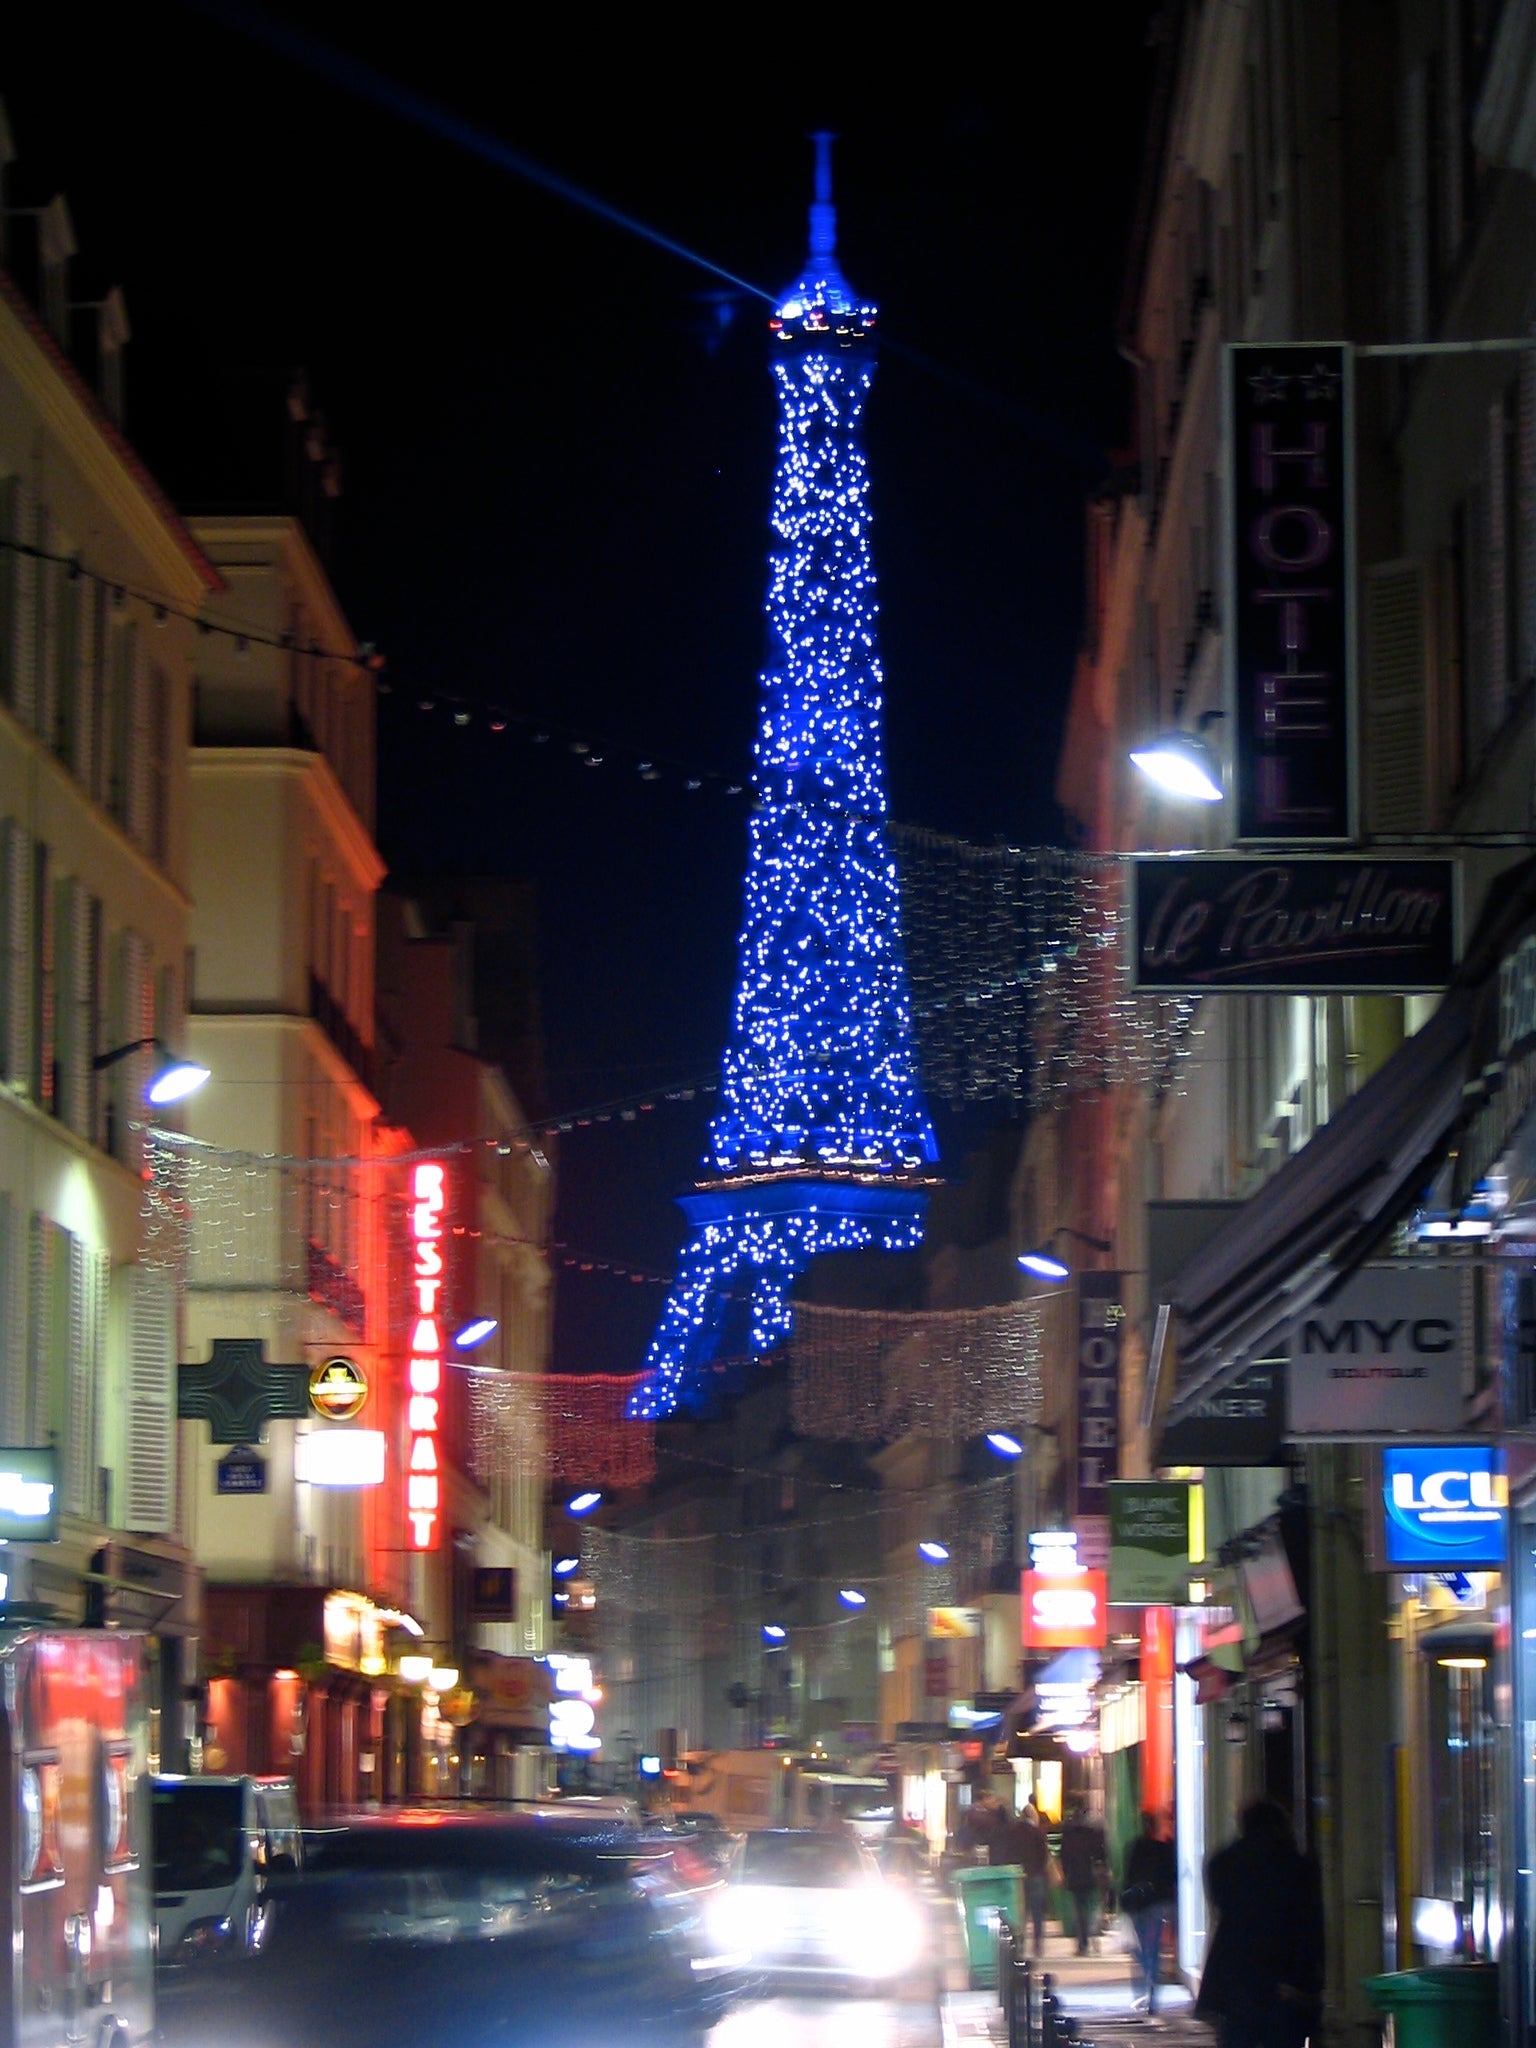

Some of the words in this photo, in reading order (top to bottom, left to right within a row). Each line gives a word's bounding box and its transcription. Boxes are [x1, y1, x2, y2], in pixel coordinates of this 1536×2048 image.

[1249, 421, 1332, 824] HOTEL
[1219, 867, 1442, 957] Pavillon
[408, 1163, 444, 1548] RESTAURANT
[1079, 1298, 1118, 1488] HOTEL
[1302, 1318, 1456, 1354] MYC
[1392, 1470, 1509, 1509] LCL
